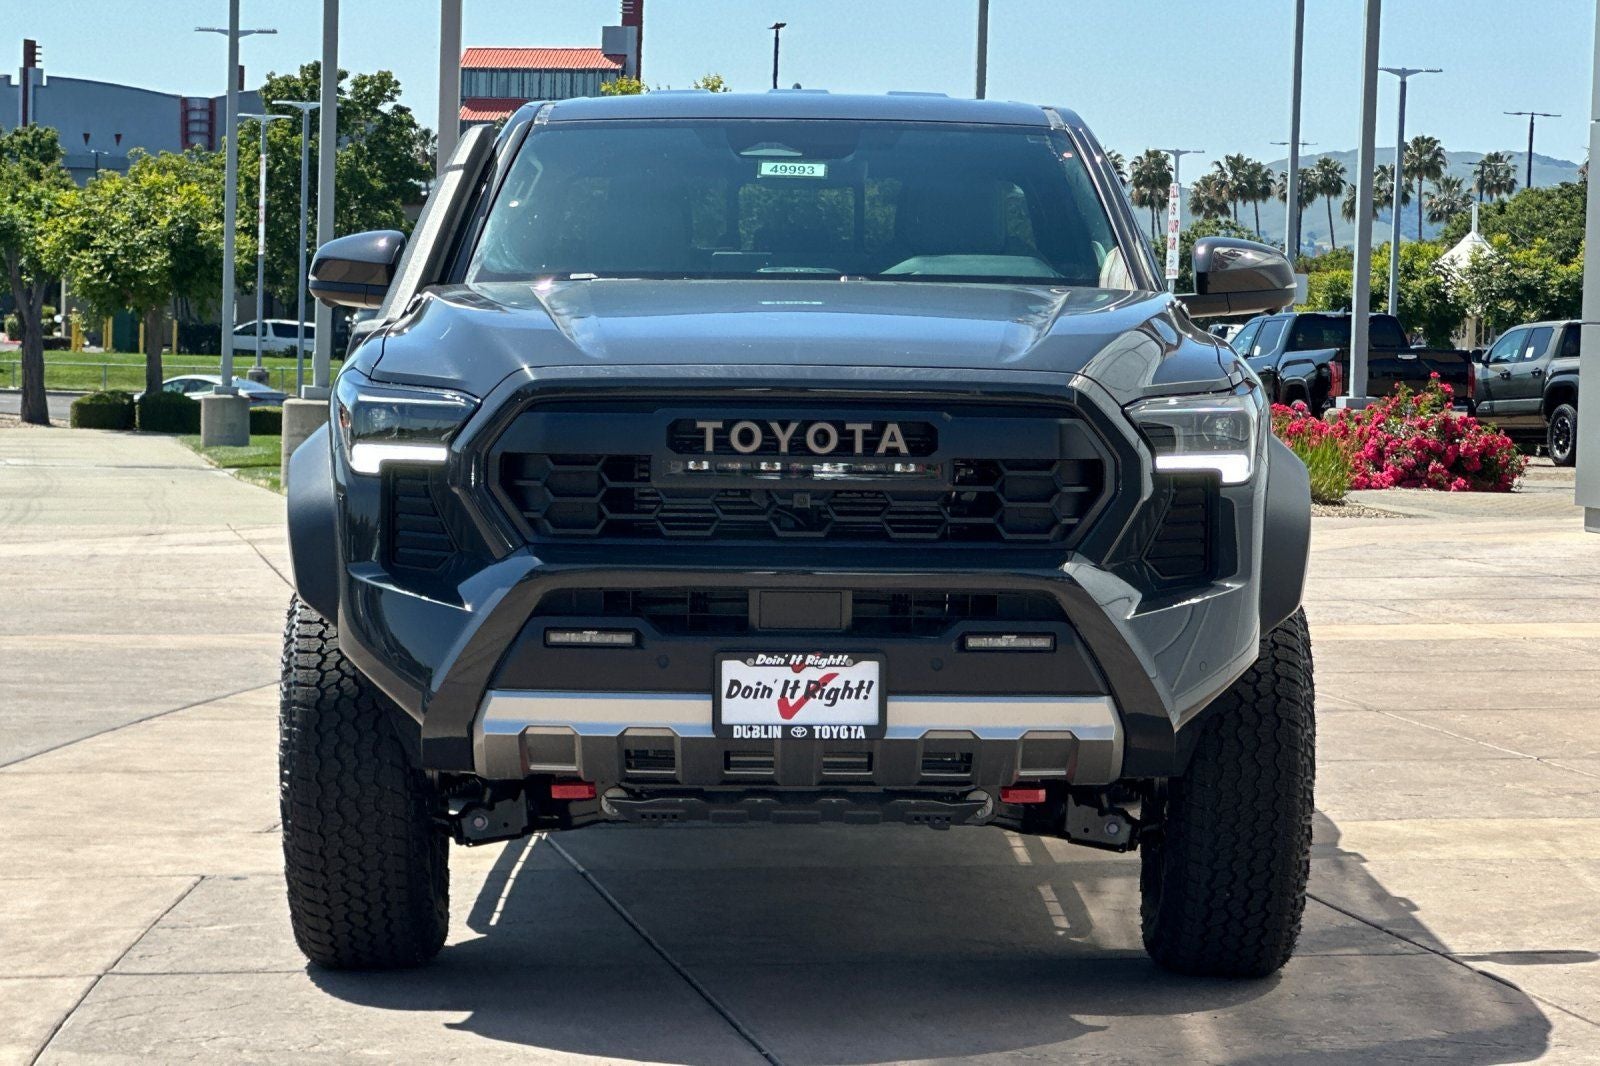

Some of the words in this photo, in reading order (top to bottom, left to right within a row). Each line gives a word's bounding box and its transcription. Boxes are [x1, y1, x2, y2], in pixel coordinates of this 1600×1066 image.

[769, 164, 815, 175] 49993
[696, 421, 910, 456] TOYOTA
[755, 654, 788, 666] Doin'
[790, 654, 805, 665] It
[805, 654, 849, 669] Right!
[725, 679, 778, 700] Doin'
[780, 679, 801, 700] It
[803, 679, 875, 707] Right!
[733, 725, 782, 739] DUBLIN
[813, 725, 866, 739] TOYOTA
